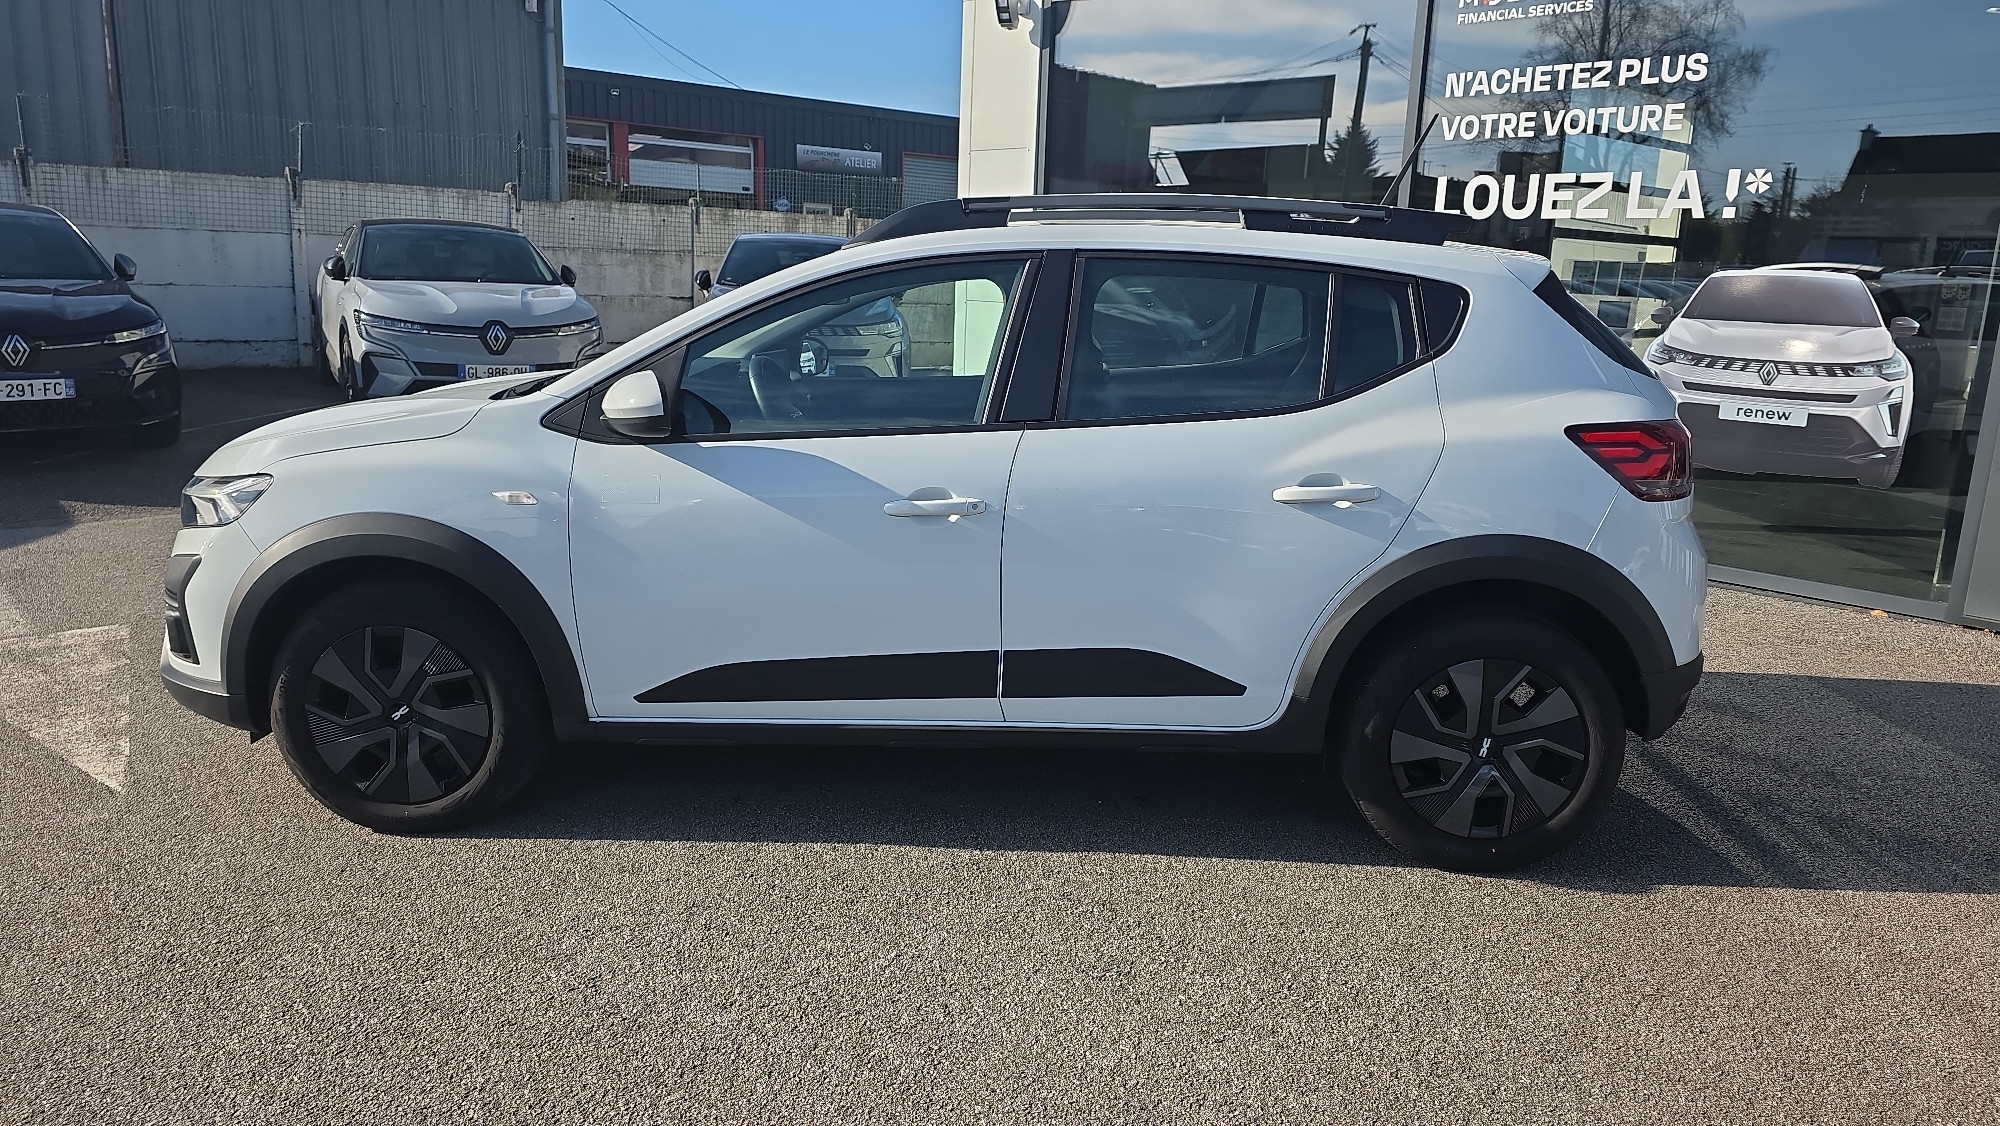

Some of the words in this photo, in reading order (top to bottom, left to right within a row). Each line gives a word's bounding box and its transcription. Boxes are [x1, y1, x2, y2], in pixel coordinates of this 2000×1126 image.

[1457, 9, 1526, 25] FINANCIAL
[1528, 0, 1594, 17] SERVICES
[1444, 60, 1613, 98] N'ACHETEZ
[1618, 52, 1709, 87] PLUS
[1441, 111, 1537, 141] VOTRE
[1543, 102, 1686, 136] VOITURE
[844, 157, 877, 169] ATELIER
[1434, 171, 1614, 221] LOUEZ
[1625, 169, 1706, 219] LA
[1736, 407, 1793, 421] renew
